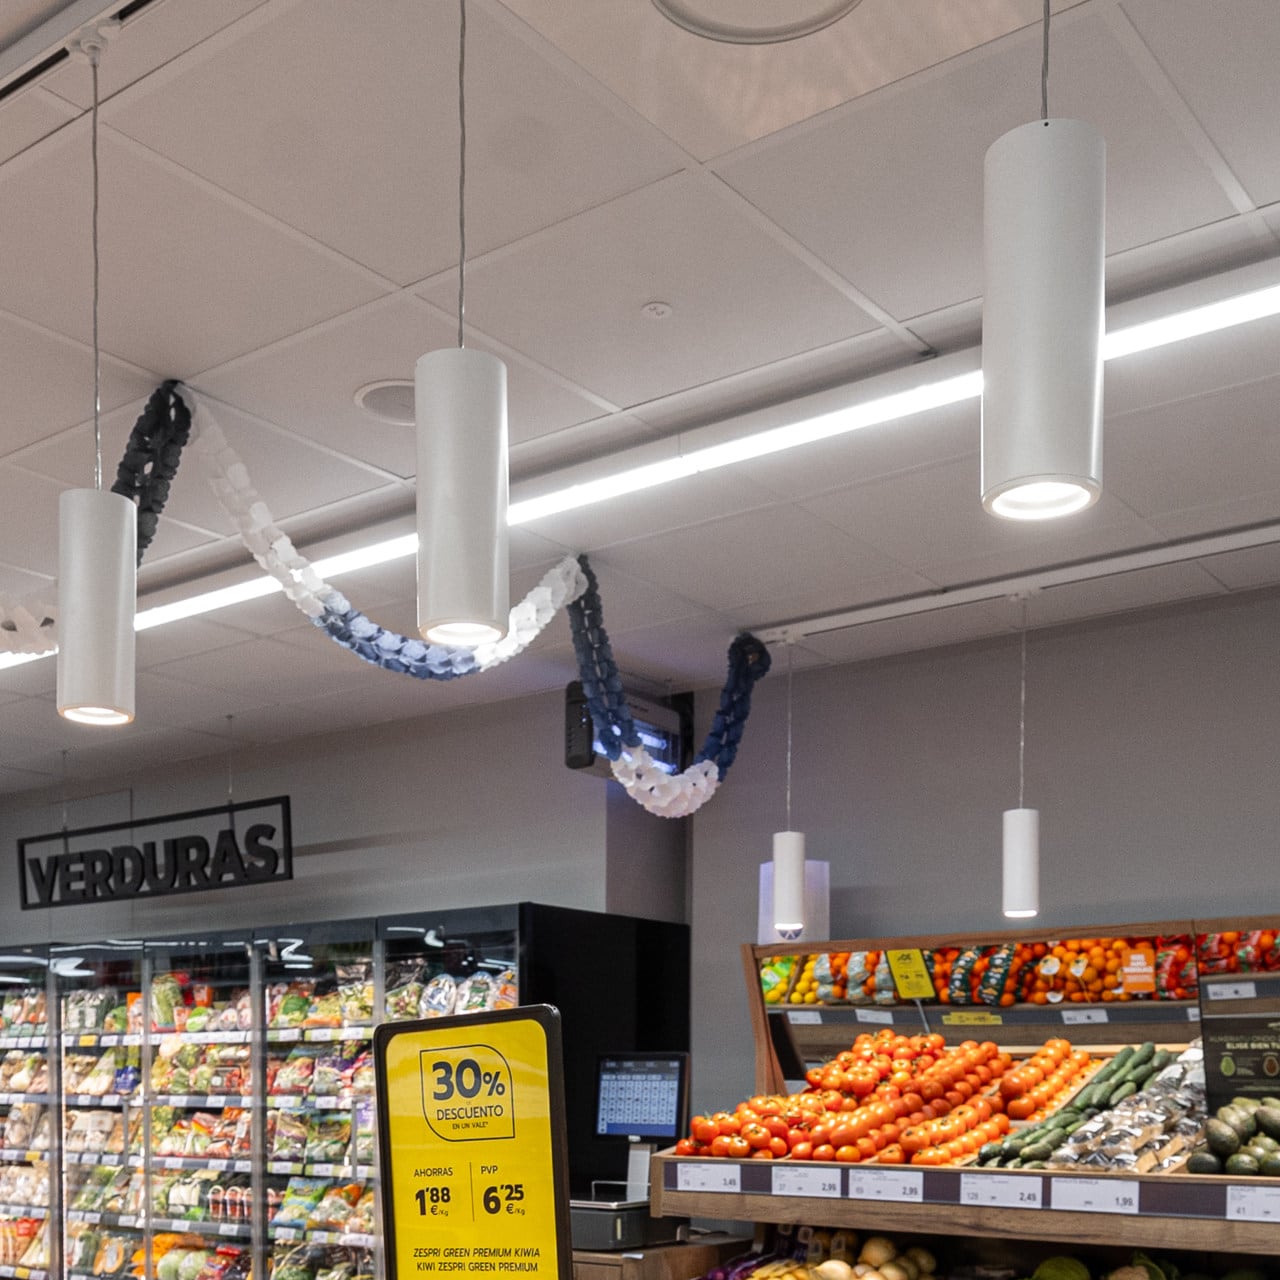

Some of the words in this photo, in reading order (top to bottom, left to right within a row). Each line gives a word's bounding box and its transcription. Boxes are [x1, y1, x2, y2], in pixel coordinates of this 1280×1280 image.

[27, 824, 278, 901] VERDURAS
[432, 1058, 505, 1101] 30%
[436, 1104, 504, 1121] DESCUENTO
[413, 1167, 453, 1177] AHORRAS
[480, 1165, 498, 1175] PVP
[413, 1248, 441, 1258] ZESPRI
[443, 1248, 470, 1258] GREEN
[472, 1248, 512, 1258] PREMIUM
[514, 1248, 540, 1258] KIWIA
[417, 1262, 435, 1271] KIWI
[438, 1262, 466, 1272] ZESPRI
[468, 1262, 496, 1272] GREEN
[498, 1262, 538, 1272] PREMIUM
